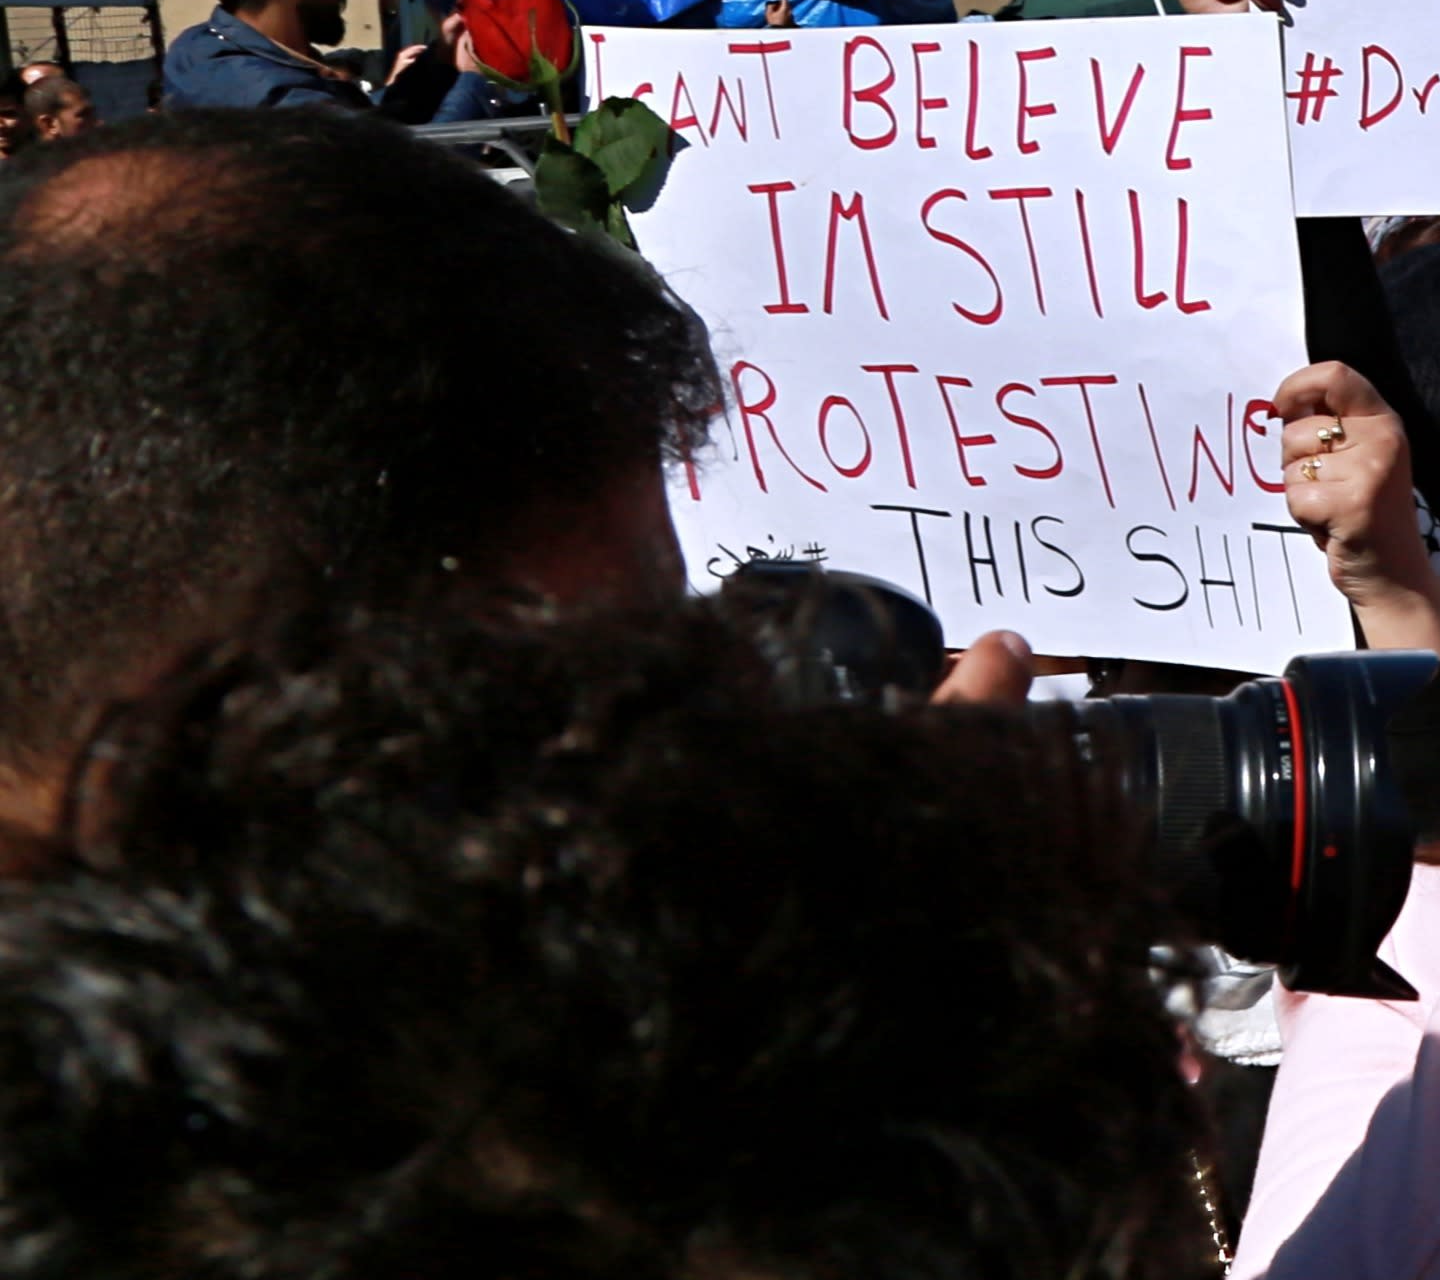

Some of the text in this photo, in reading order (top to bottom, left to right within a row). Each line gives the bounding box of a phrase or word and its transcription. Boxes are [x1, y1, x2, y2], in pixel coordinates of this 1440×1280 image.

[842, 34, 1214, 170] BELEVE
[918, 187, 1212, 325] STILL
[681, 360, 1286, 510] ROTESTING
[870, 504, 1312, 636] THIS SHIT
